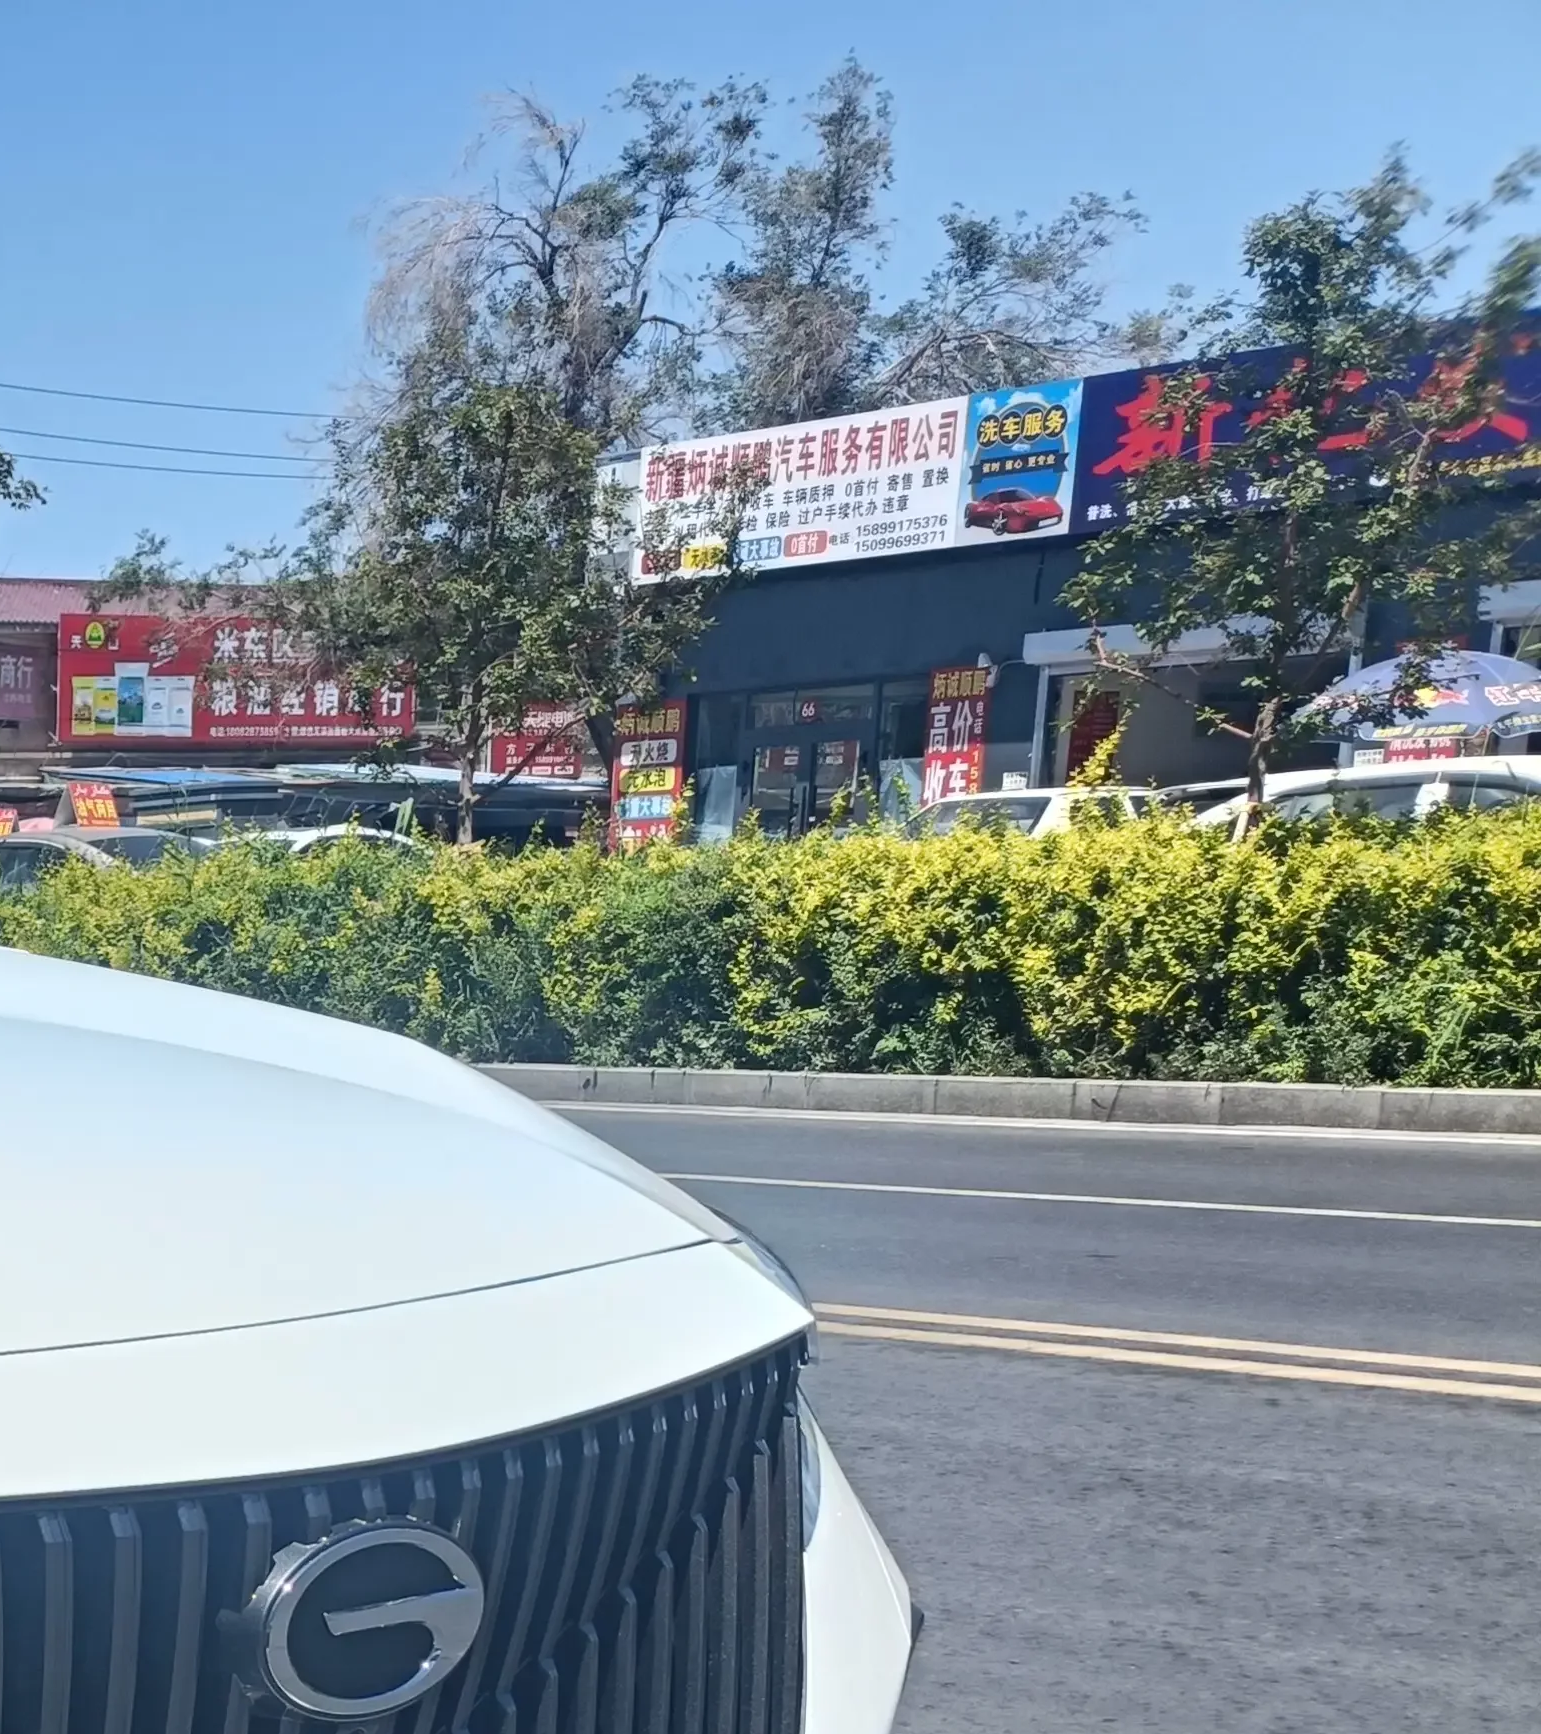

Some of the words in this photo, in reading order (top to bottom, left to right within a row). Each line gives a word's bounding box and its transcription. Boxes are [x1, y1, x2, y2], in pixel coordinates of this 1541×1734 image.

[978, 404, 1066, 444] 洗车服务
[782, 484, 835, 507] 车辆质押
[845, 478, 879, 498] 0首付
[887, 473, 913, 491] 寄售
[922, 466, 950, 488] 置换
[766, 511, 791, 529] 保险
[798, 499, 878, 525] 过户手续代办
[882, 494, 910, 514] 违章
[790, 532, 819, 554] 0首付
[828, 532, 850, 546] 电话
[856, 514, 948, 537] 15899175376
[854, 530, 945, 553] 15099699371
[801, 702, 815, 717] 66
[928, 700, 974, 755] 高价
[923, 758, 969, 804] 收车
